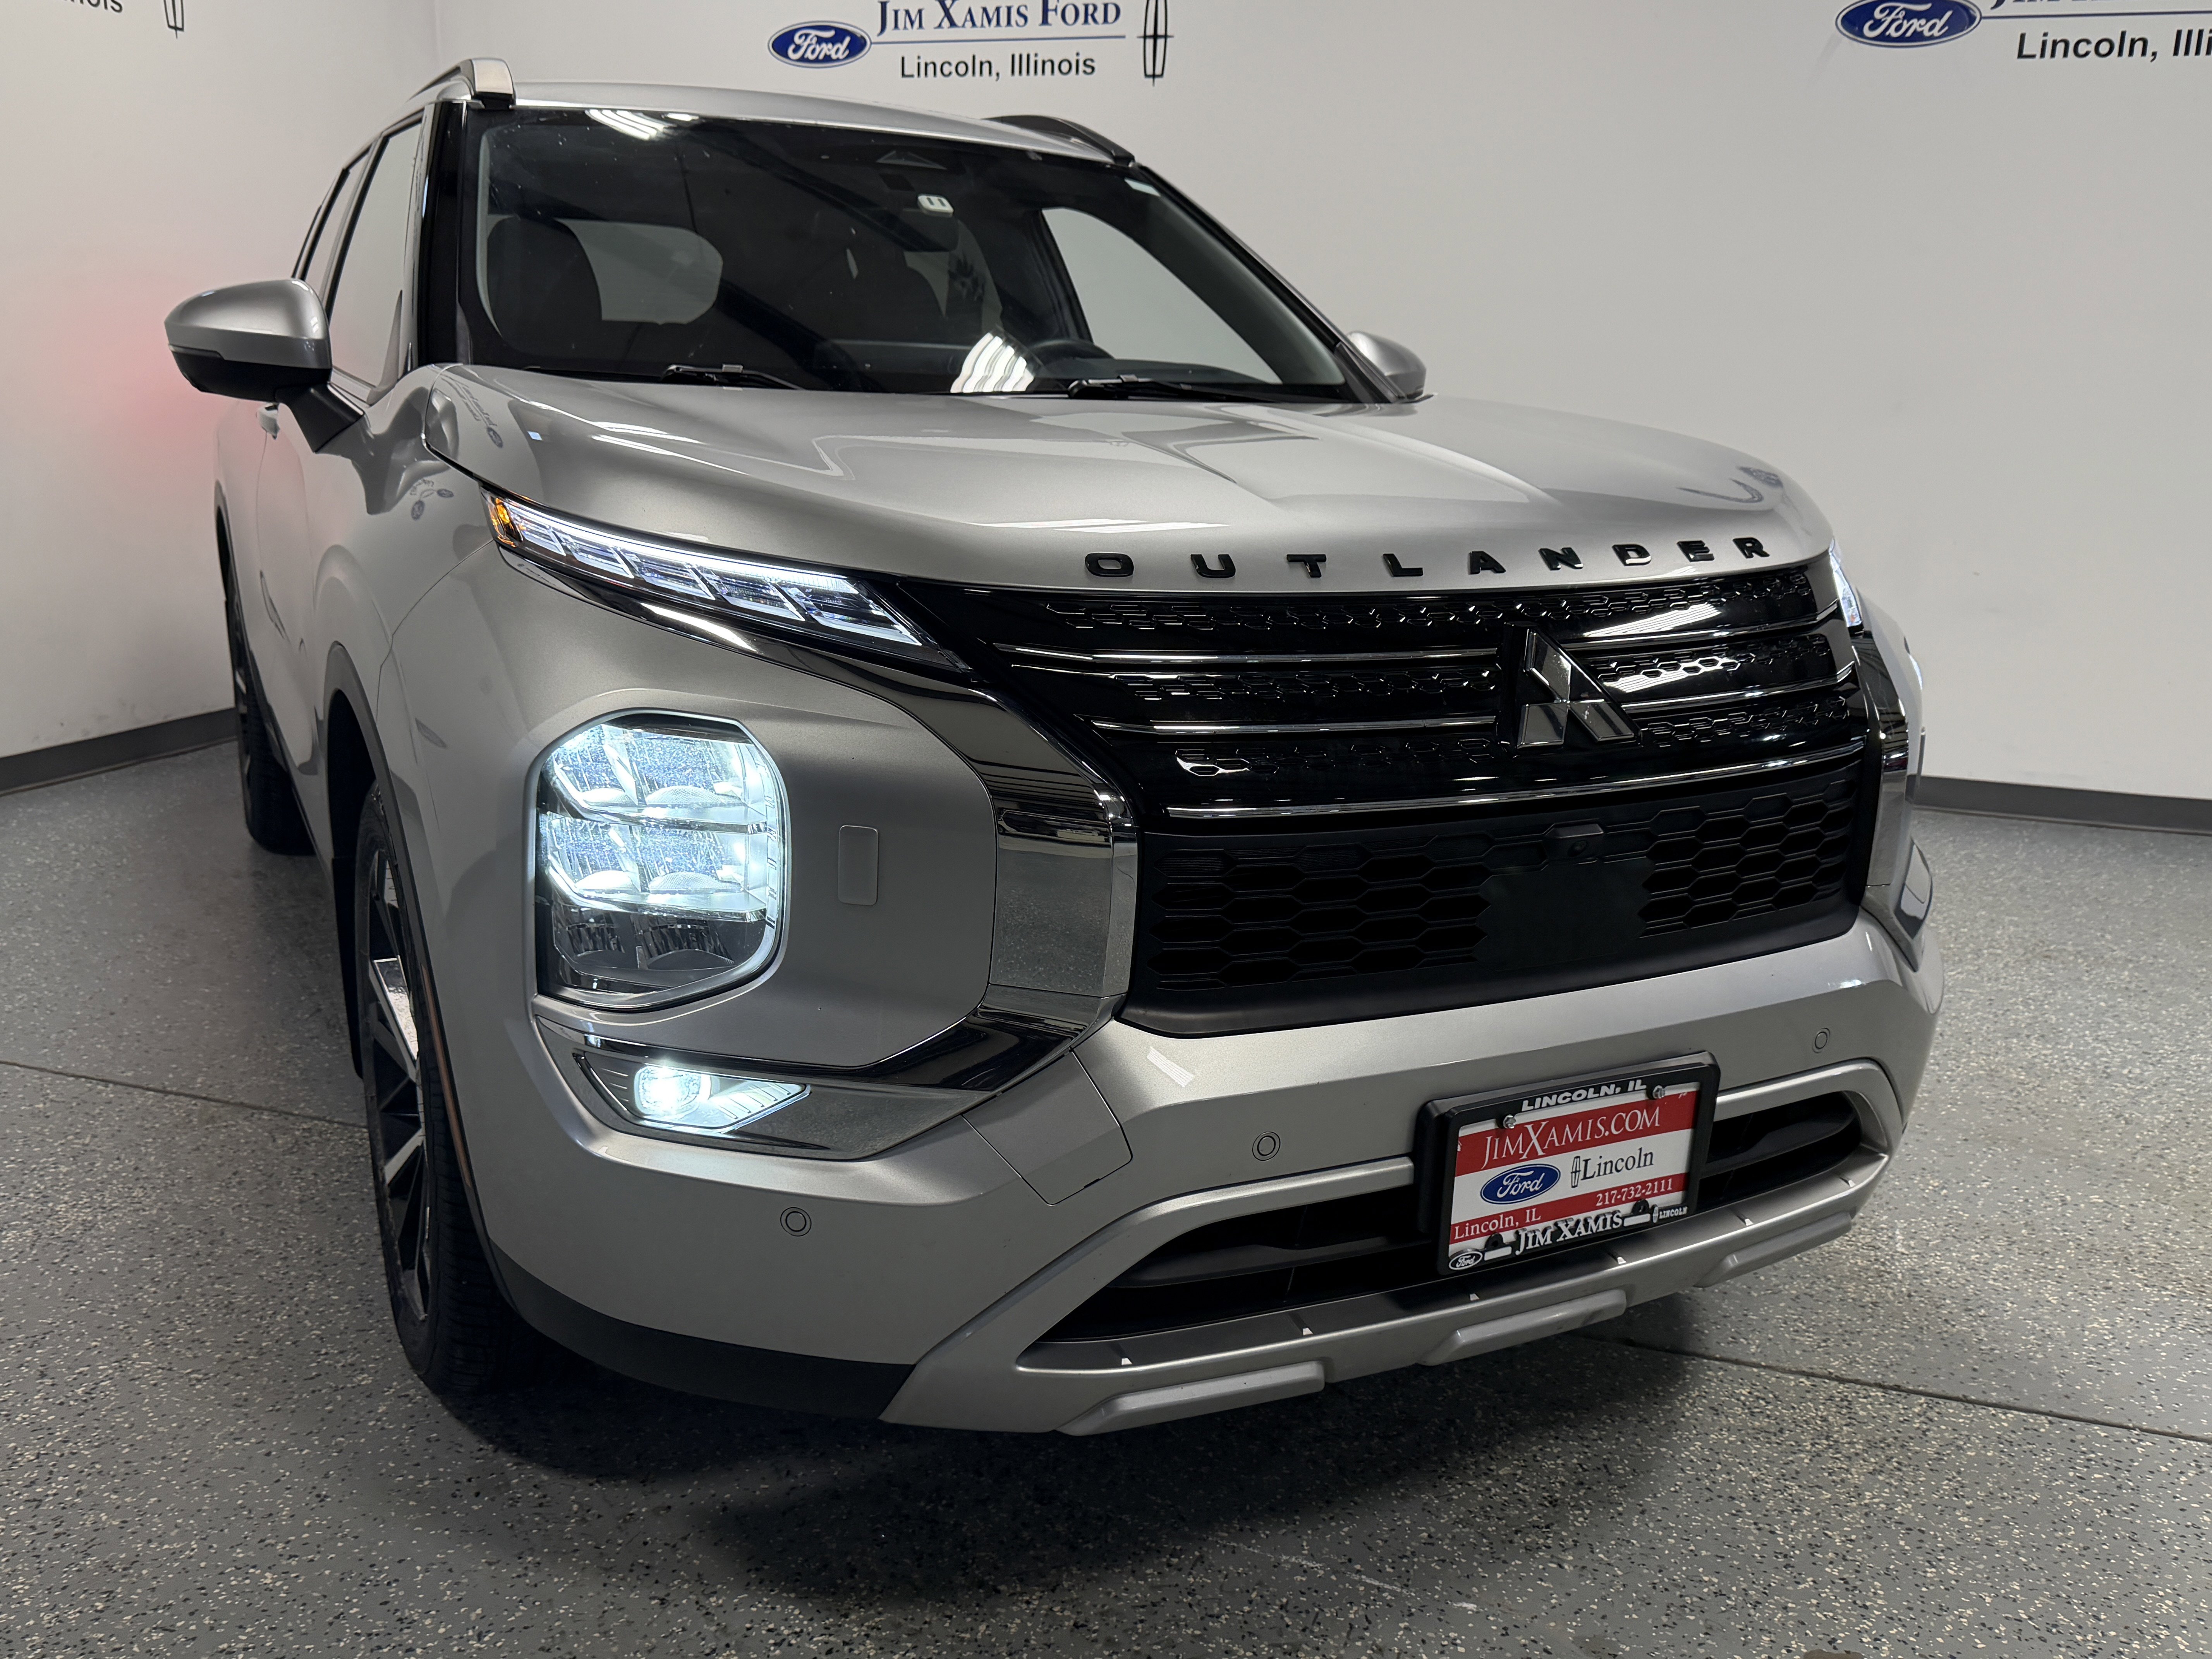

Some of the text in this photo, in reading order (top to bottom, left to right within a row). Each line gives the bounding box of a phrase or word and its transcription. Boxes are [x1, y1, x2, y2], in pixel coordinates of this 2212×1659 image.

[877, 0, 1121, 36] JIM XAMIS FORD
[1863, 3, 1949, 38] Ford
[787, 30, 849, 60] Ford
[2017, 30, 2158, 62] Lincoln,
[901, 53, 1096, 81] Lincoln, Illinois
[1085, 538, 1771, 579] OUTLANDER
[1522, 1080, 1647, 1111] LINCOLN, IL
[1581, 1147, 1654, 1181] Lincoln
[1496, 1170, 1544, 1198] Ford
[1596, 1178, 1673, 1206] 217-732-2111
[1454, 1208, 1541, 1239] Lincoln, IL
[1659, 1206, 1688, 1219] LINCOLN
[1516, 1212, 1623, 1255] JIM XAMIS
